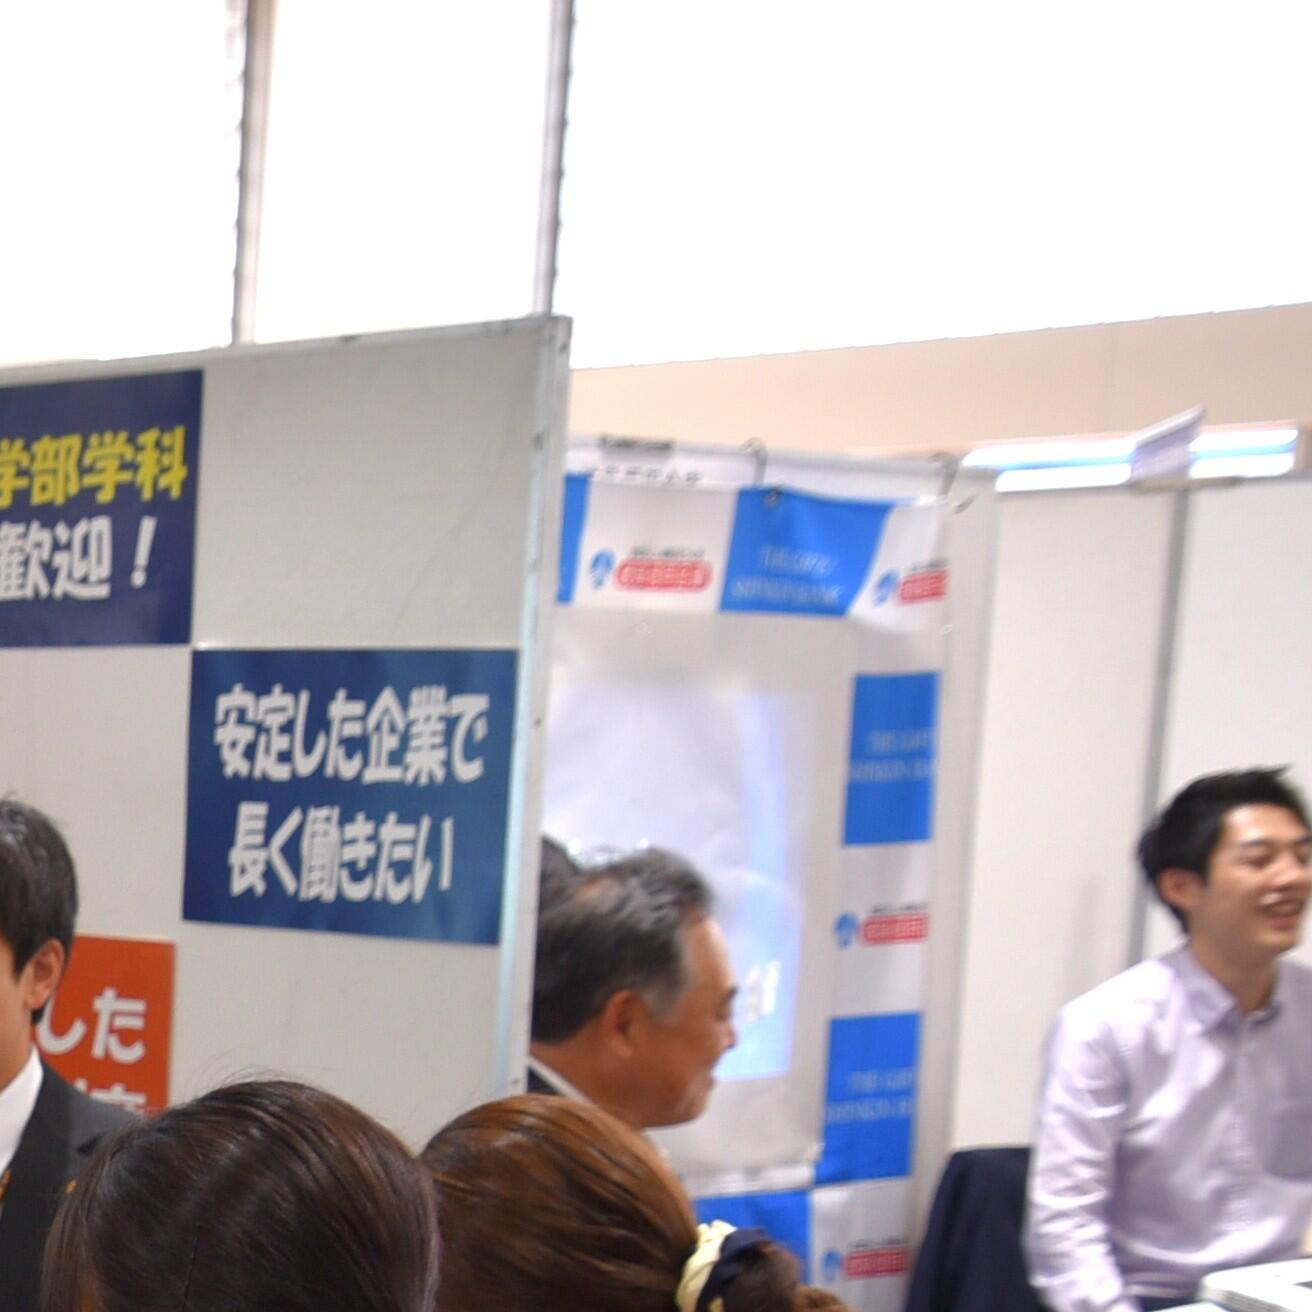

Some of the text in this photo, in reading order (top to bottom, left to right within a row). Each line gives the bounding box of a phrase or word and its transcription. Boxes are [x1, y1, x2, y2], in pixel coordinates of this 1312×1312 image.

[213, 683, 489, 787] 安定した企業で
[227, 802, 454, 904] 長く働きたい
